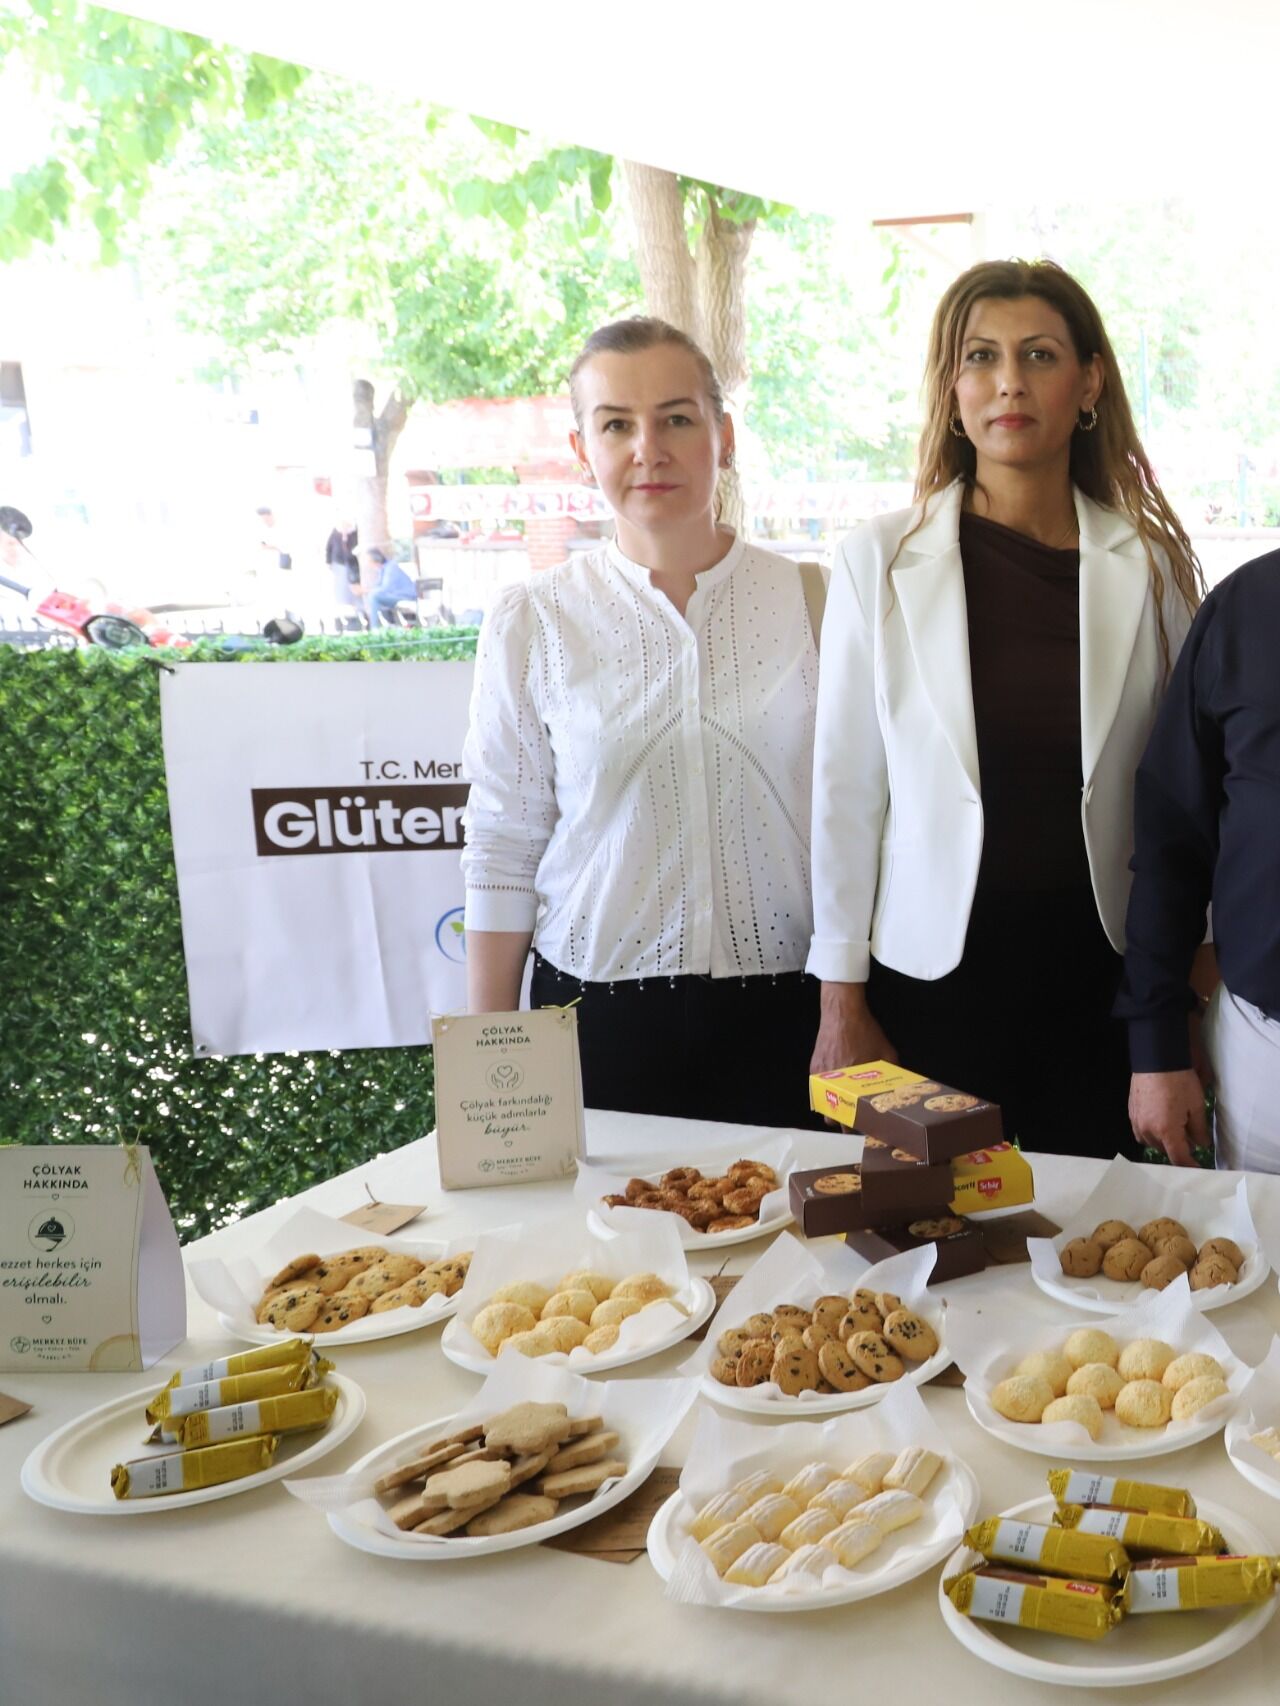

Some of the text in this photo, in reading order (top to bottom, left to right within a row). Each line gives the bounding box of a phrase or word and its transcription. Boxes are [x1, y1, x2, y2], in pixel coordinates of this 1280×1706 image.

[360, 760, 407, 781] T.C.
[482, 1026, 524, 1036] ÇÖLYAK
[476, 1037, 531, 1047] HAKKINDA
[32, 1164, 81, 1177] ÇÖLYAK
[23, 1179, 89, 1190] HAKKINDA
[0, 1258, 102, 1273] ezzet herkes için
[25, 1294, 67, 1305] olmalı.
